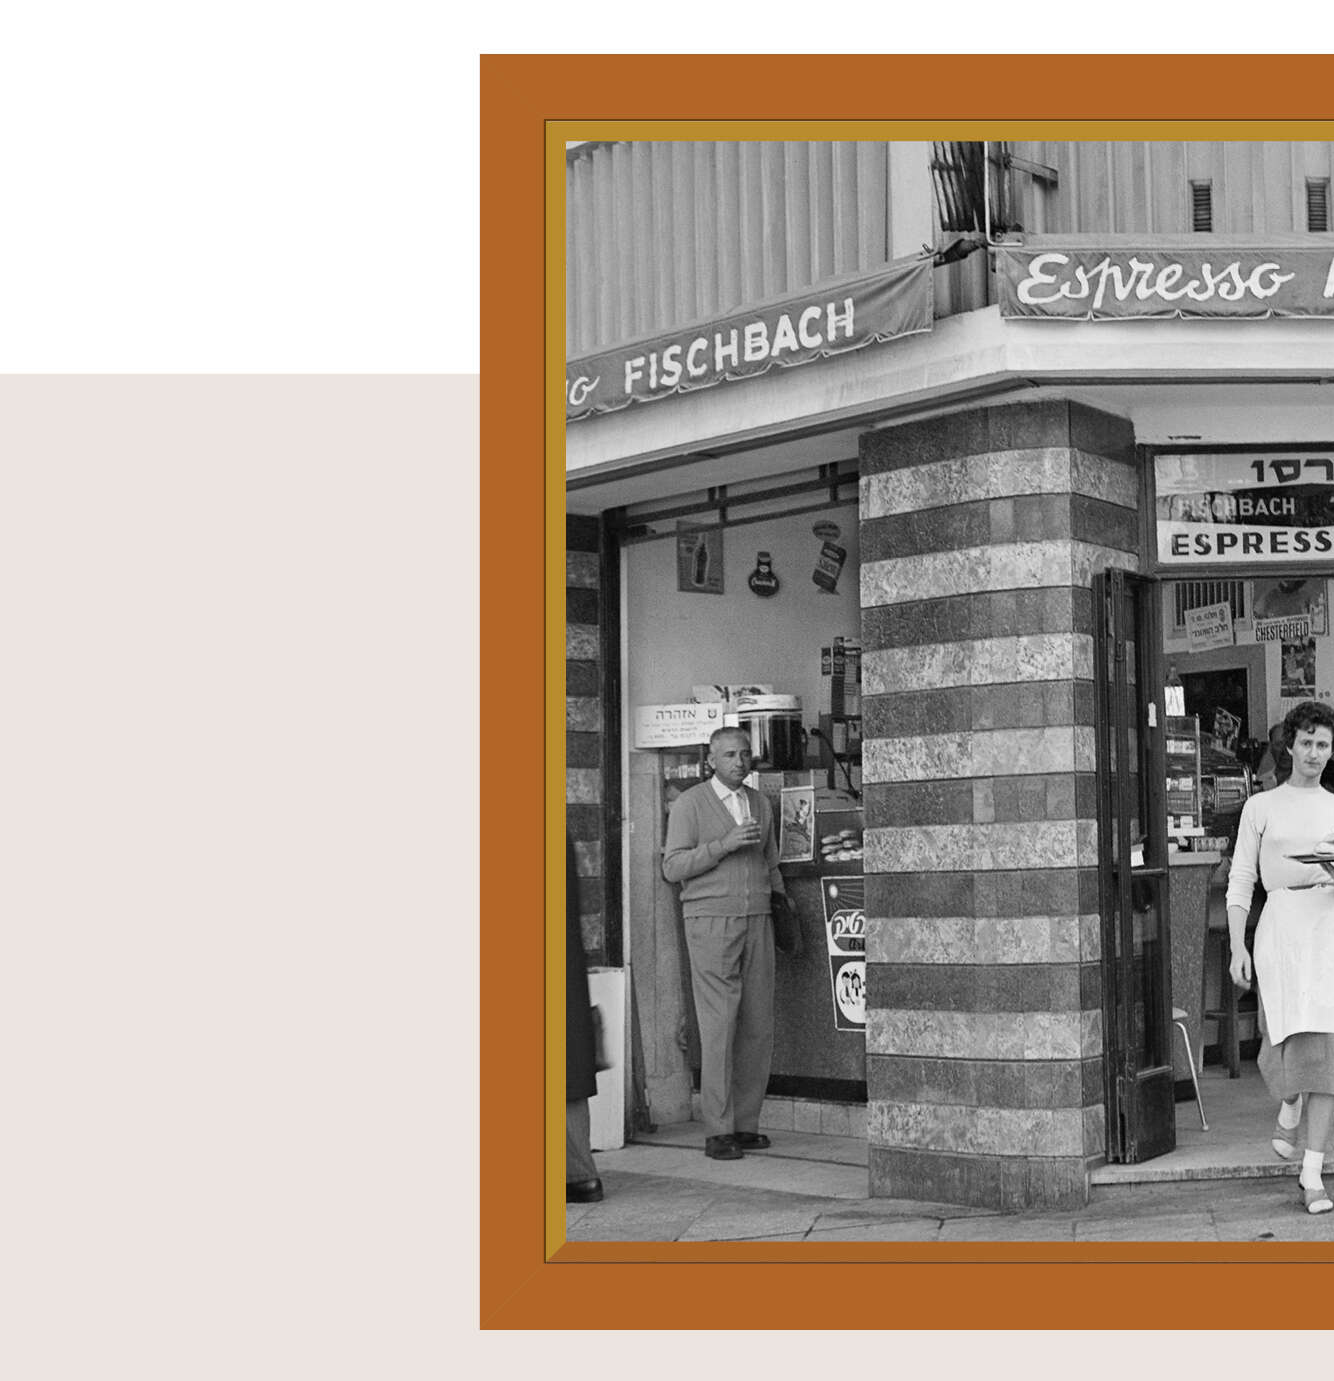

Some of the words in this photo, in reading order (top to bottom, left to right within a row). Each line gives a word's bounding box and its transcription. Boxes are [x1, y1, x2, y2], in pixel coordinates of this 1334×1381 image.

[1016, 253, 1295, 309] Espresso
[623, 298, 855, 393] FISCHBACH
[1179, 497, 1296, 517] FISCHBACH
[1255, 621, 1309, 642] CHESTERFIELD
[655, 709, 696, 720] אזהרה
[833, 911, 866, 940] רטיק
